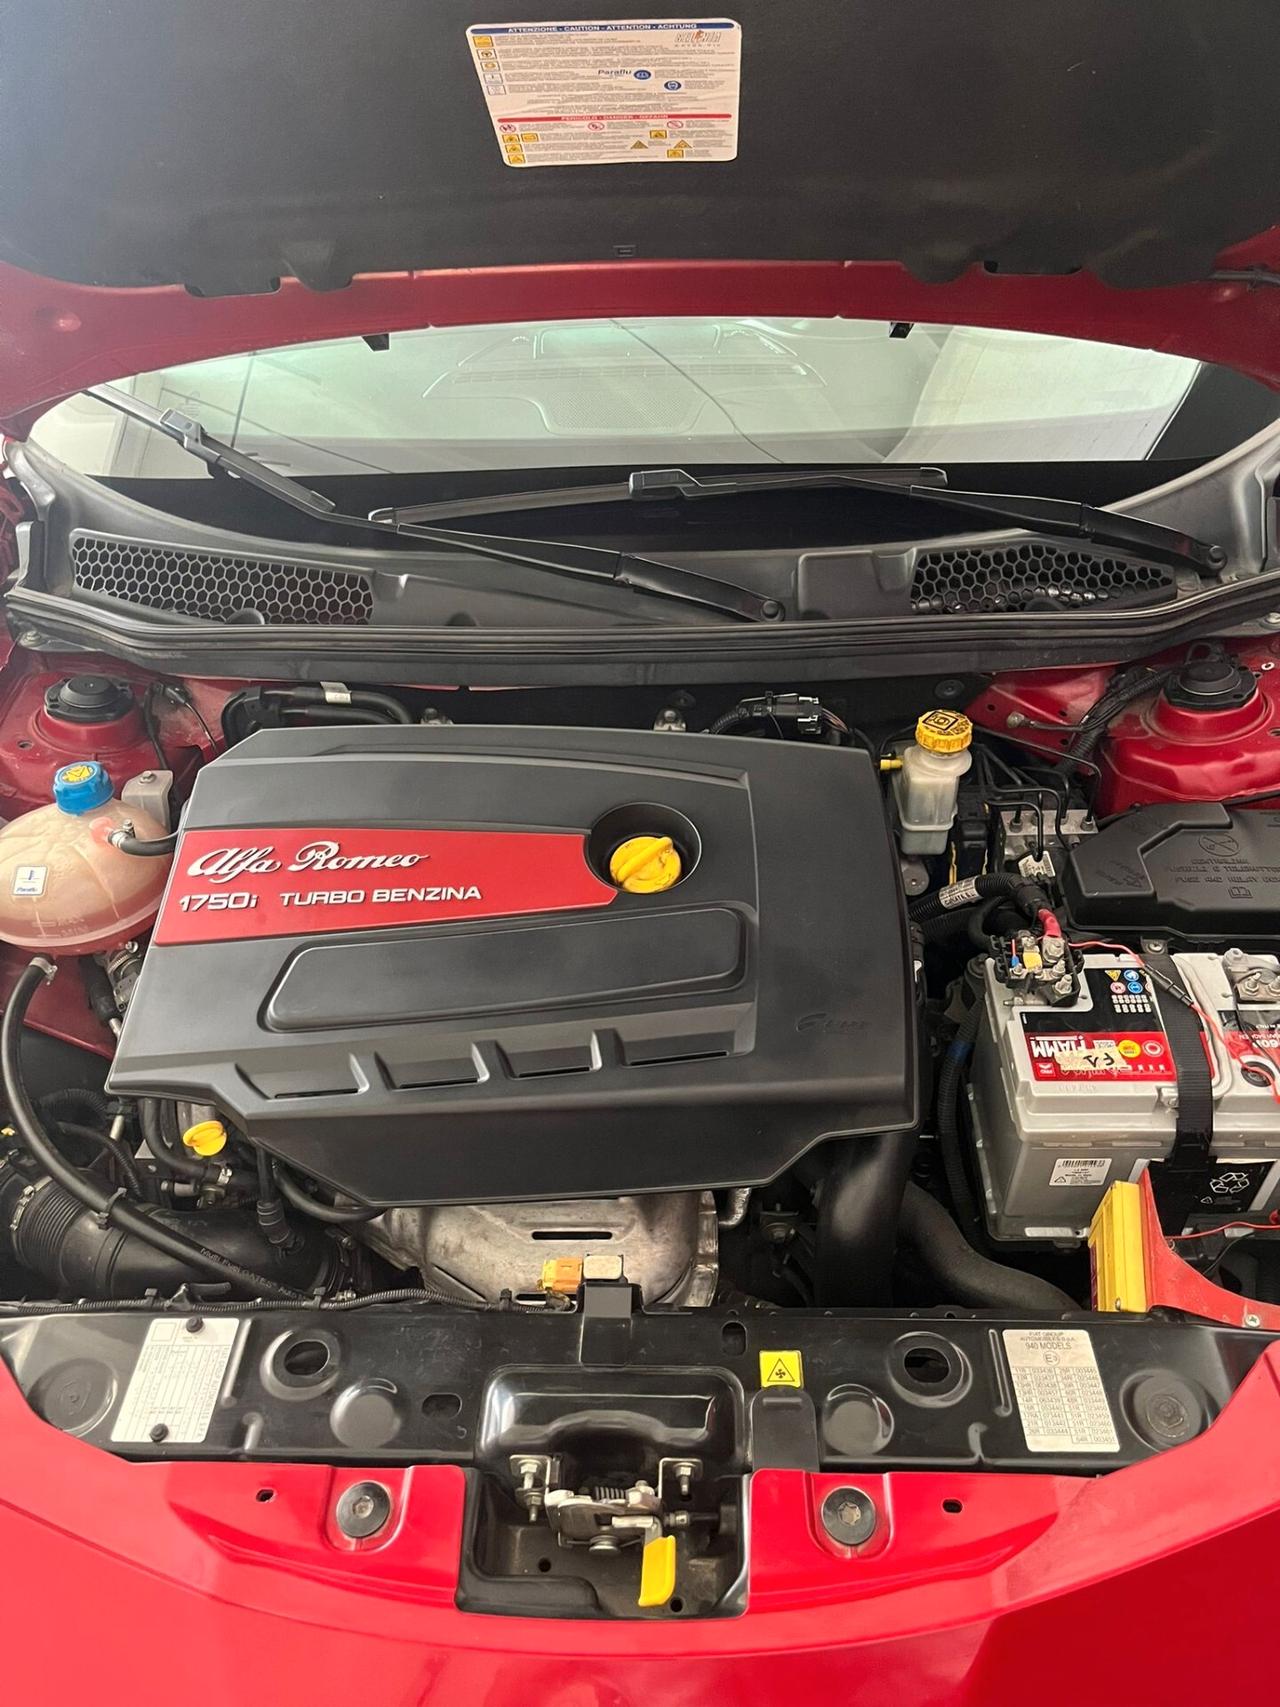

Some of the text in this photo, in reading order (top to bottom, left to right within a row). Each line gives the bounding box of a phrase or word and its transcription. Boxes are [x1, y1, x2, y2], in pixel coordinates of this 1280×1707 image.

[187, 840, 431, 884] Alfa Romeo
[180, 886, 481, 912] 1750i TURBO BENZINA
[1039, 1342, 1072, 1350] MODELS
